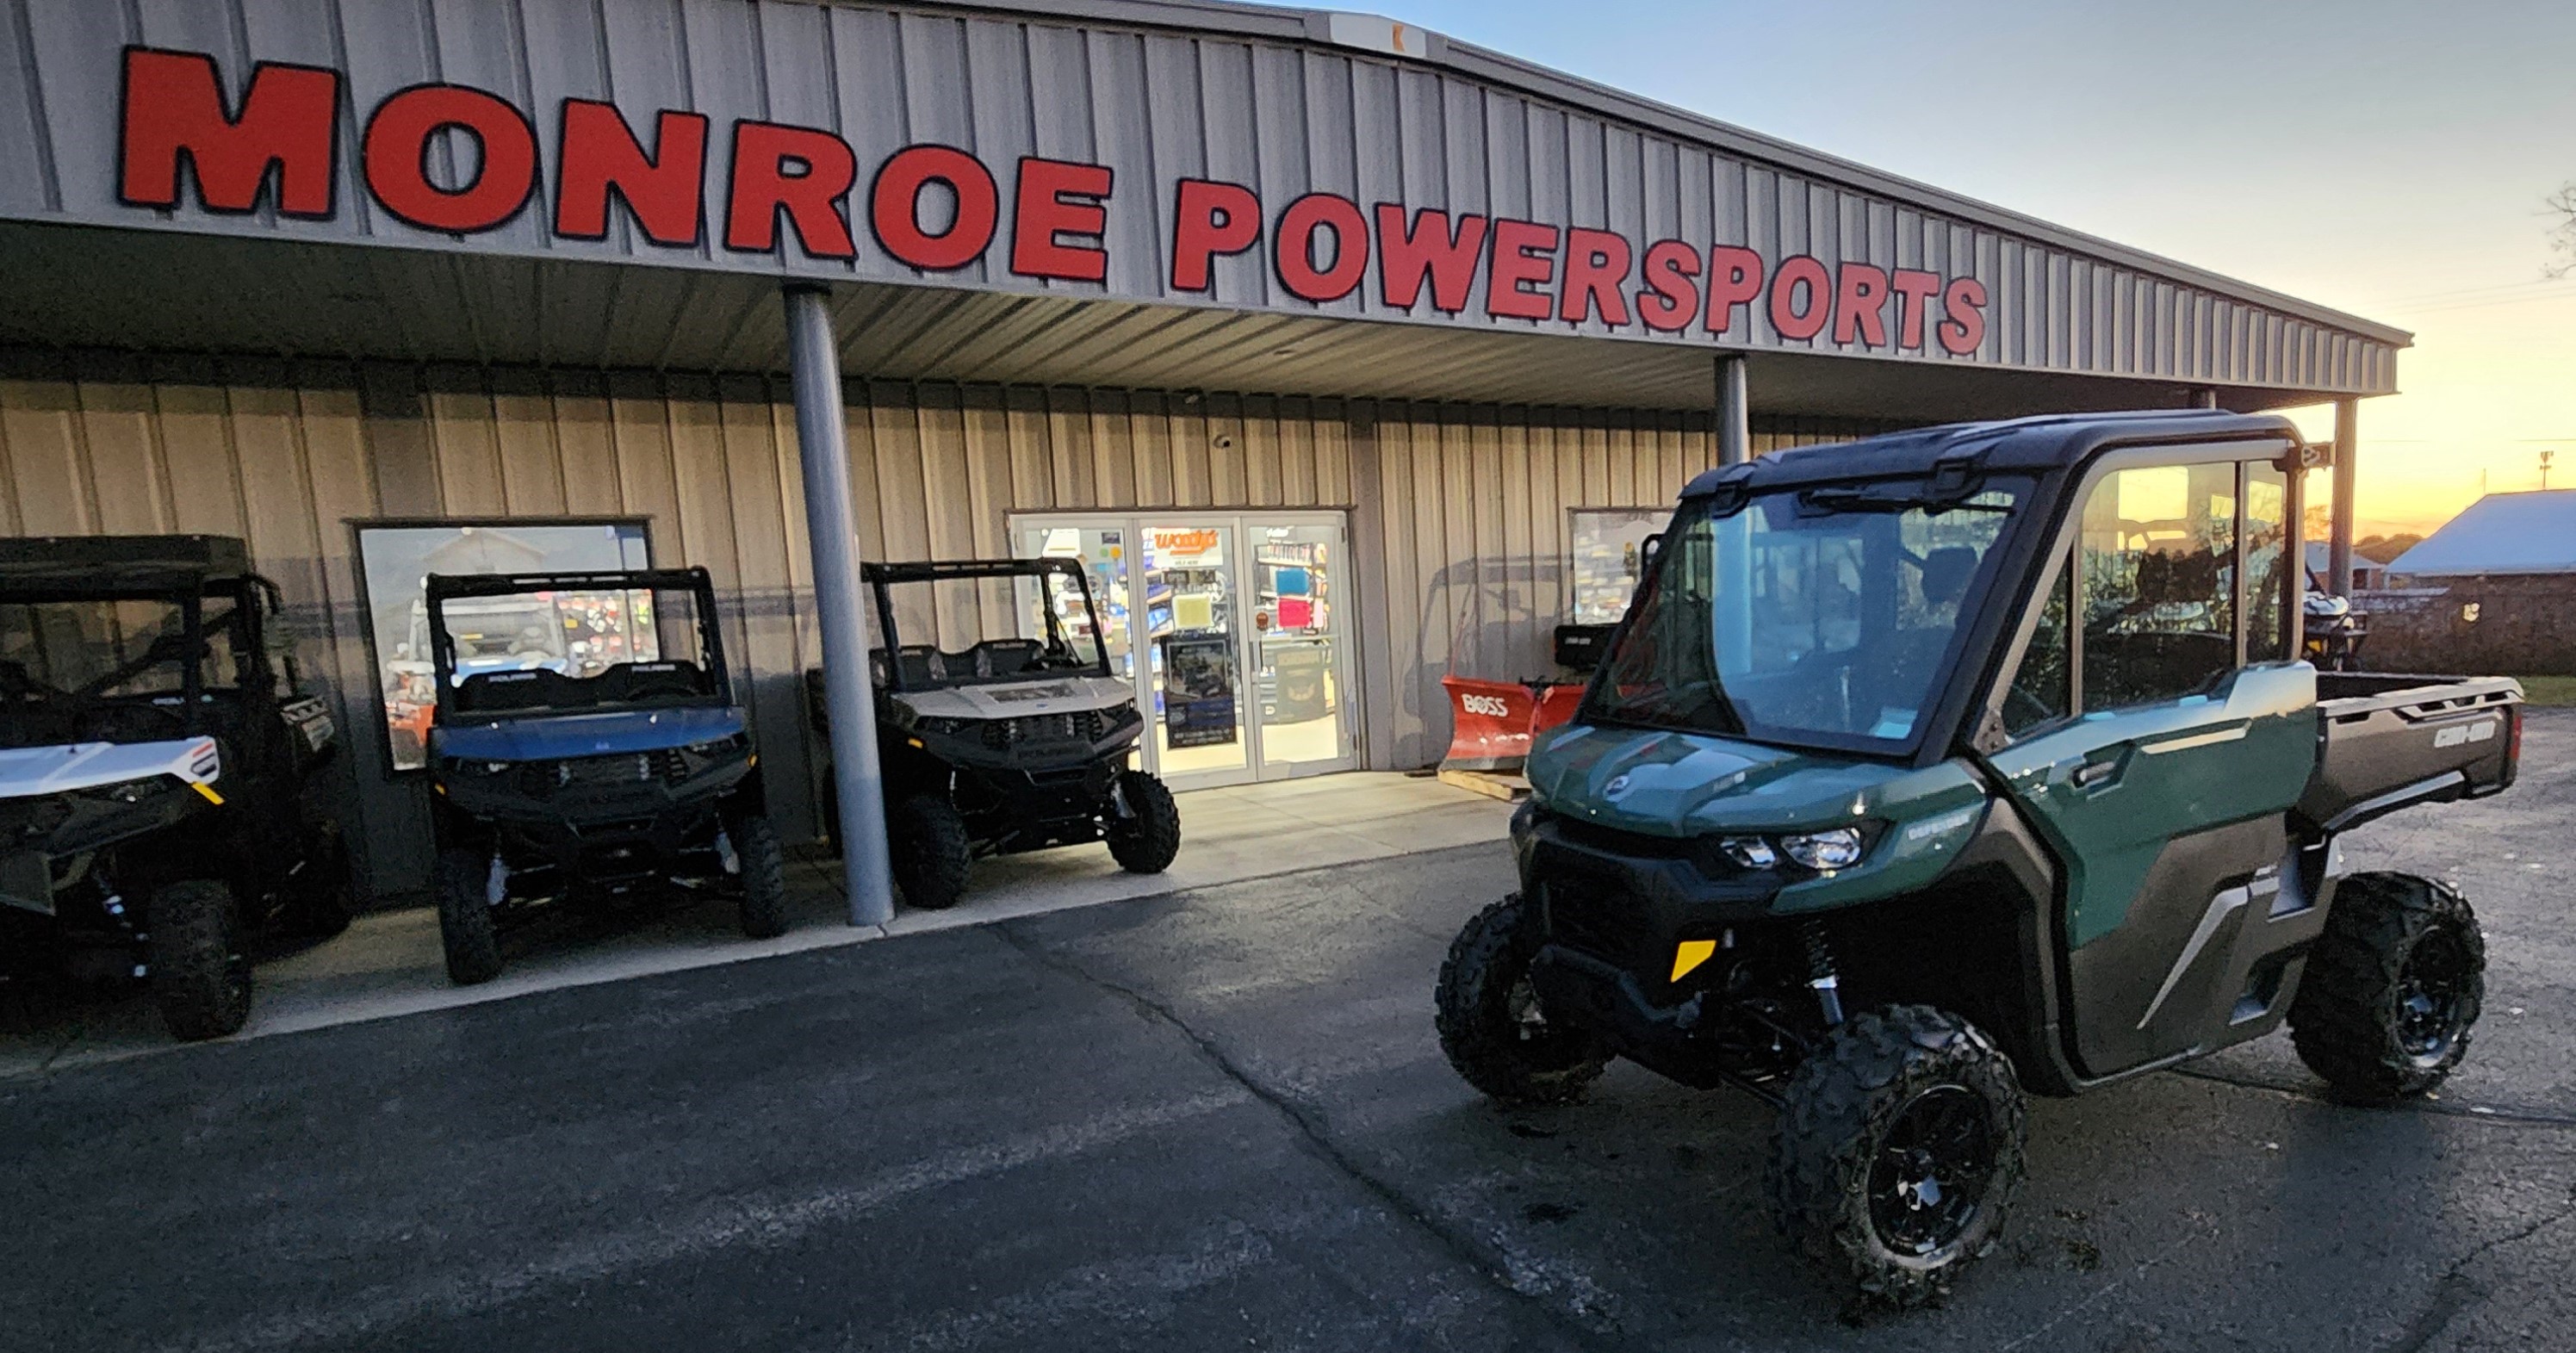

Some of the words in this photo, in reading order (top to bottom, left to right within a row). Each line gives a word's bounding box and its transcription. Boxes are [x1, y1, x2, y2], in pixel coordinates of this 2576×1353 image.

[121, 48, 1113, 282] MONROE
[1170, 177, 1988, 356] POWERSPORTS
[1461, 692, 1509, 717] BOSS
